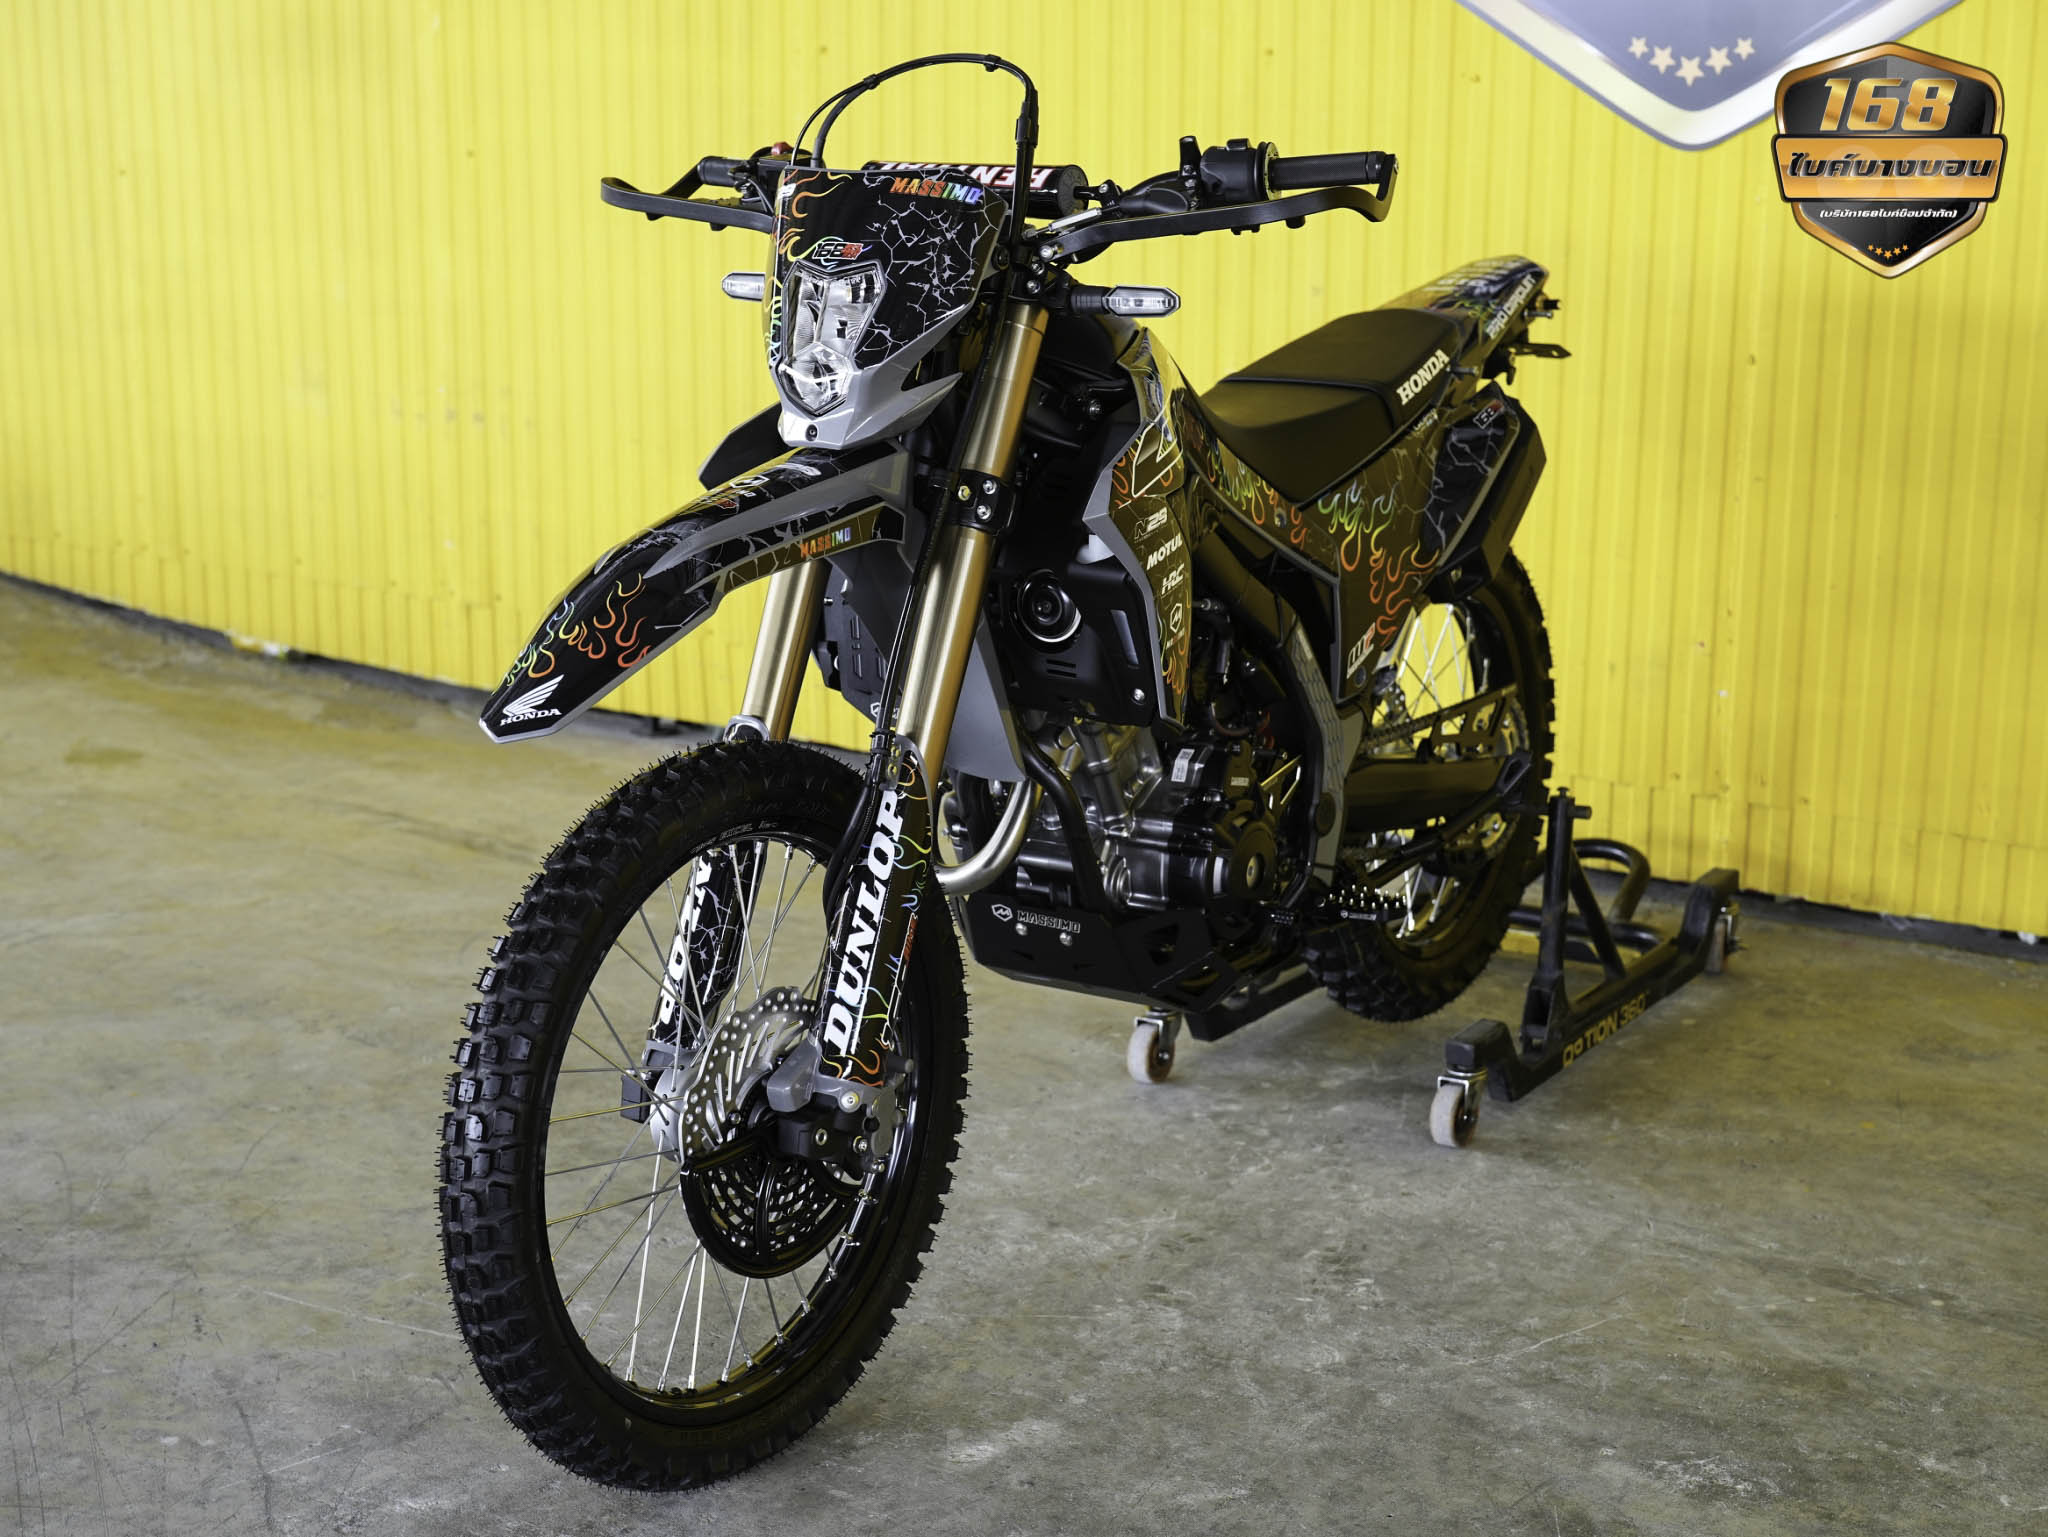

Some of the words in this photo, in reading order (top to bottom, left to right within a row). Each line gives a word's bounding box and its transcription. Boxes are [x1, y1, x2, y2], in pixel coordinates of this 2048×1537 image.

[889, 176, 982, 205] MASSIMO
[1396, 349, 1450, 405] HONDA
[800, 527, 851, 559] MASSIMO
[1146, 532, 1183, 571] MOTUL
[500, 707, 563, 726] HONDA
[822, 789, 906, 1058] DUNLOP
[1017, 909, 1081, 934] MASSIMO
